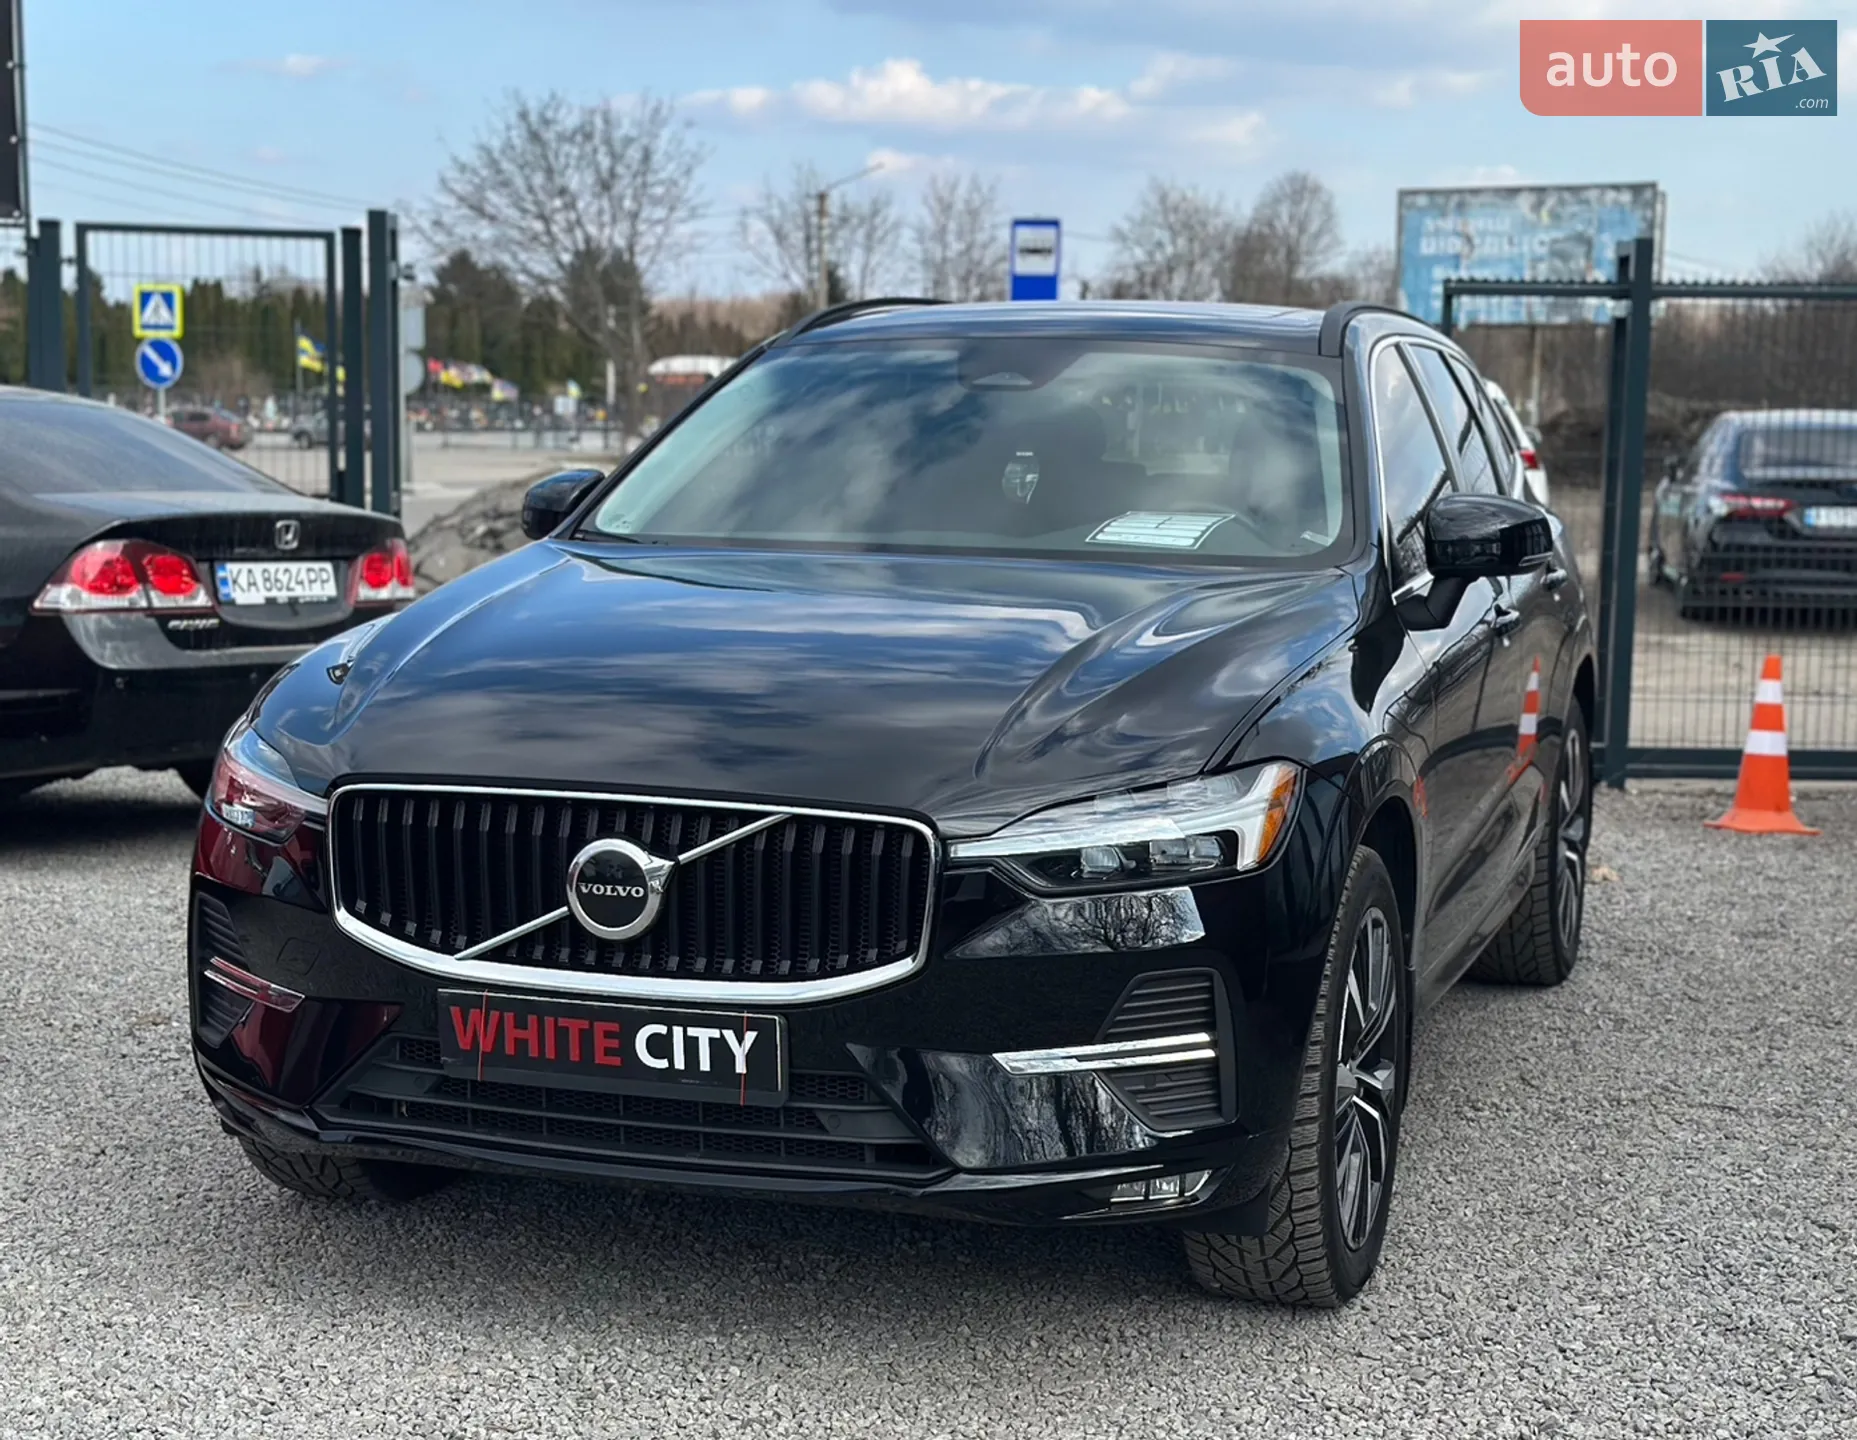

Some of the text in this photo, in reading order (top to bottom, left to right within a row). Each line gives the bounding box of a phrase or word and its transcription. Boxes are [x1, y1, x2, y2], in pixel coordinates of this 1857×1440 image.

[578, 882, 645, 898] VOLVO
[450, 1005, 758, 1074] WHITE CITY
